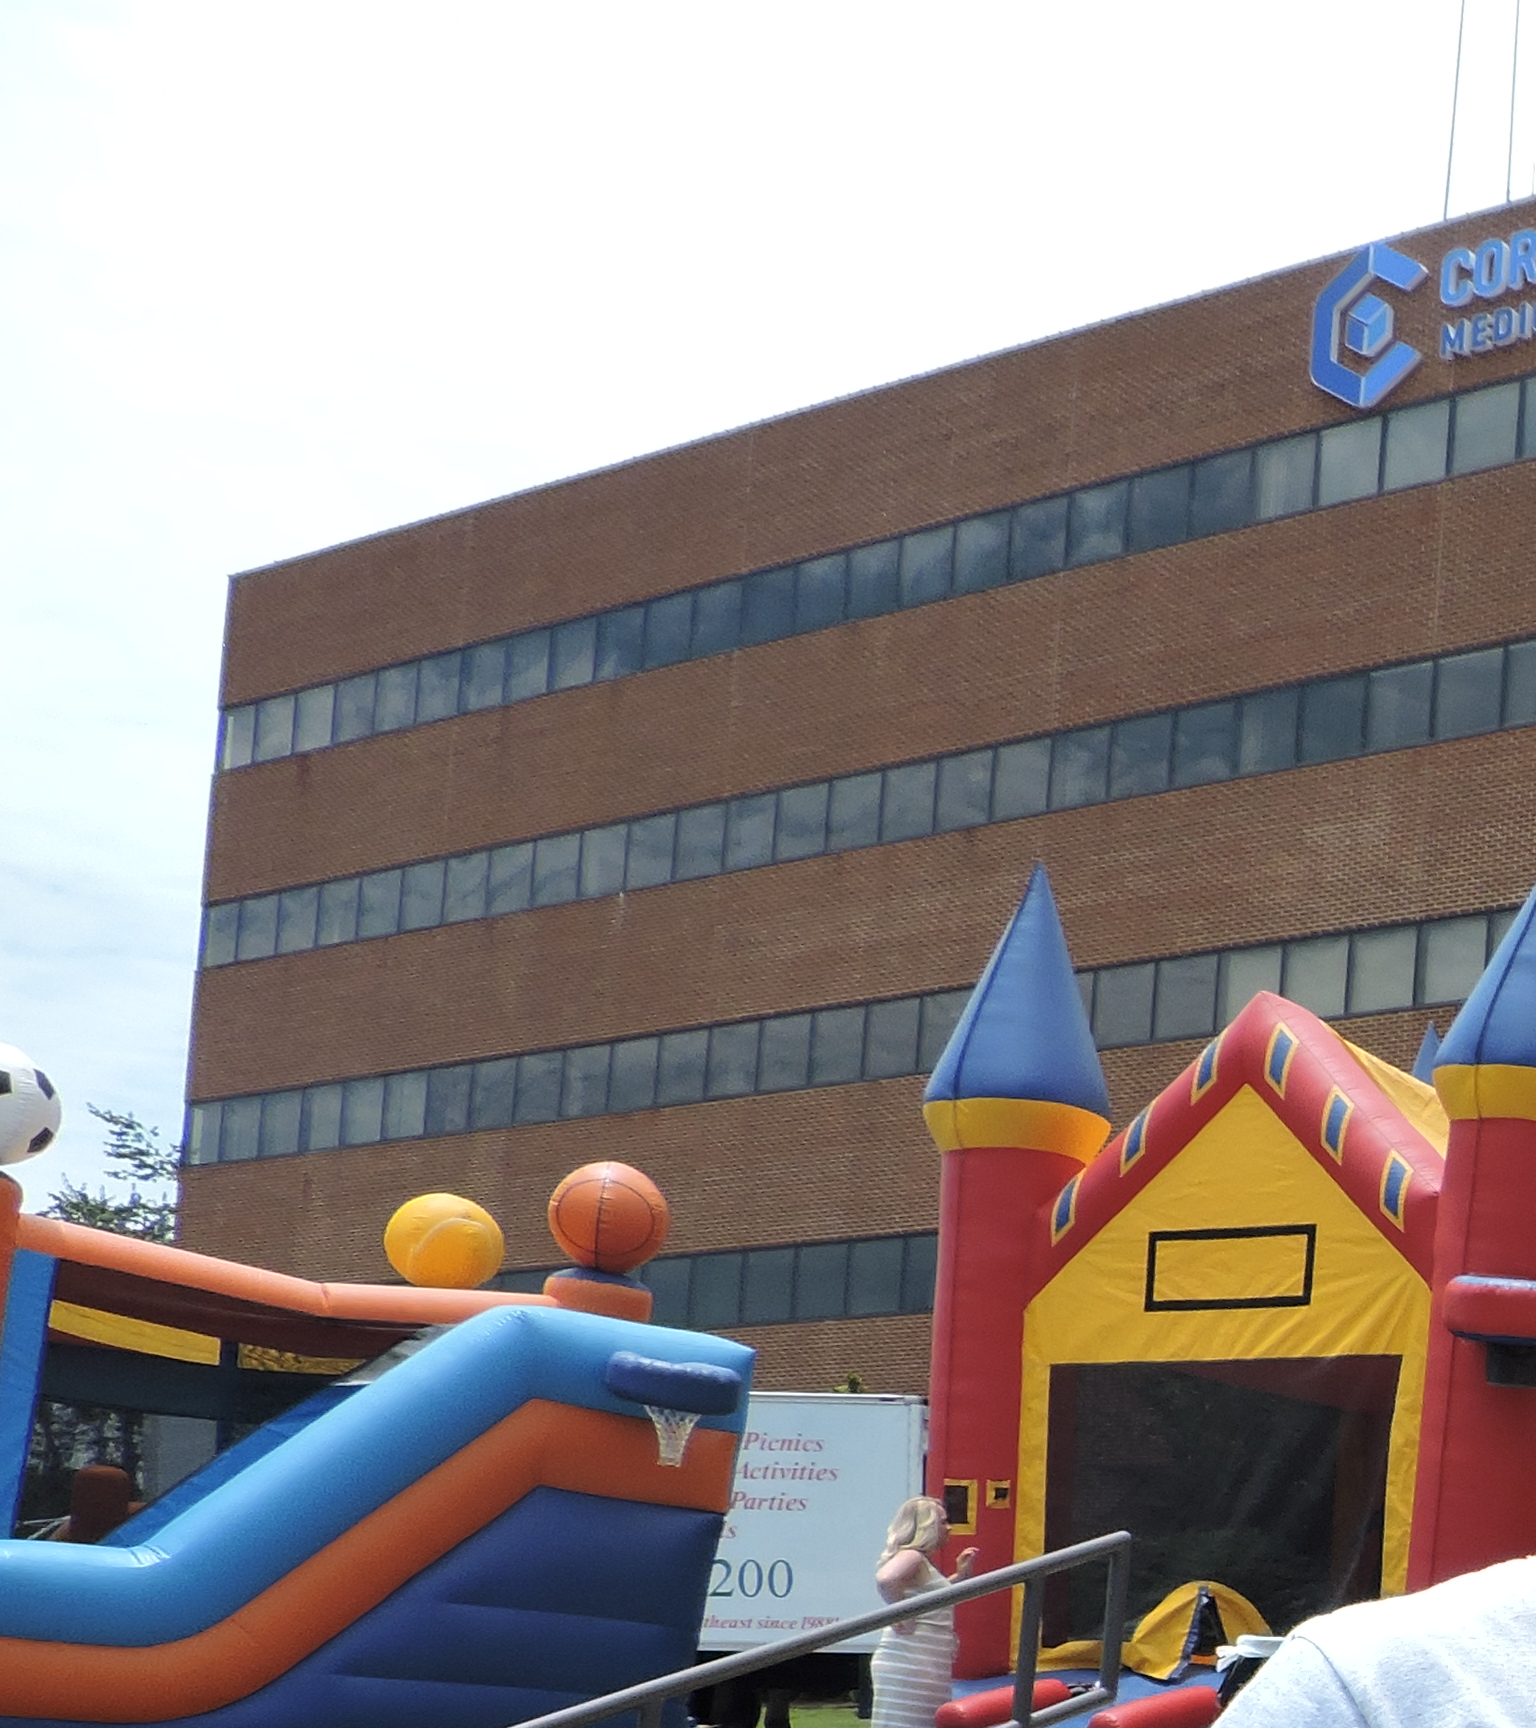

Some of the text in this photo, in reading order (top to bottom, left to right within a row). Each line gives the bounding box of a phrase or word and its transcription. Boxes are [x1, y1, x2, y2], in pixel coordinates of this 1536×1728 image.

[743, 1431, 824, 1452] Picnics
[737, 1461, 839, 1481] Activities
[730, 1491, 808, 1511] Parties
[708, 1559, 793, 1598] 200
[702, 1614, 752, 1630] theast
[757, 1615, 798, 1630] since
